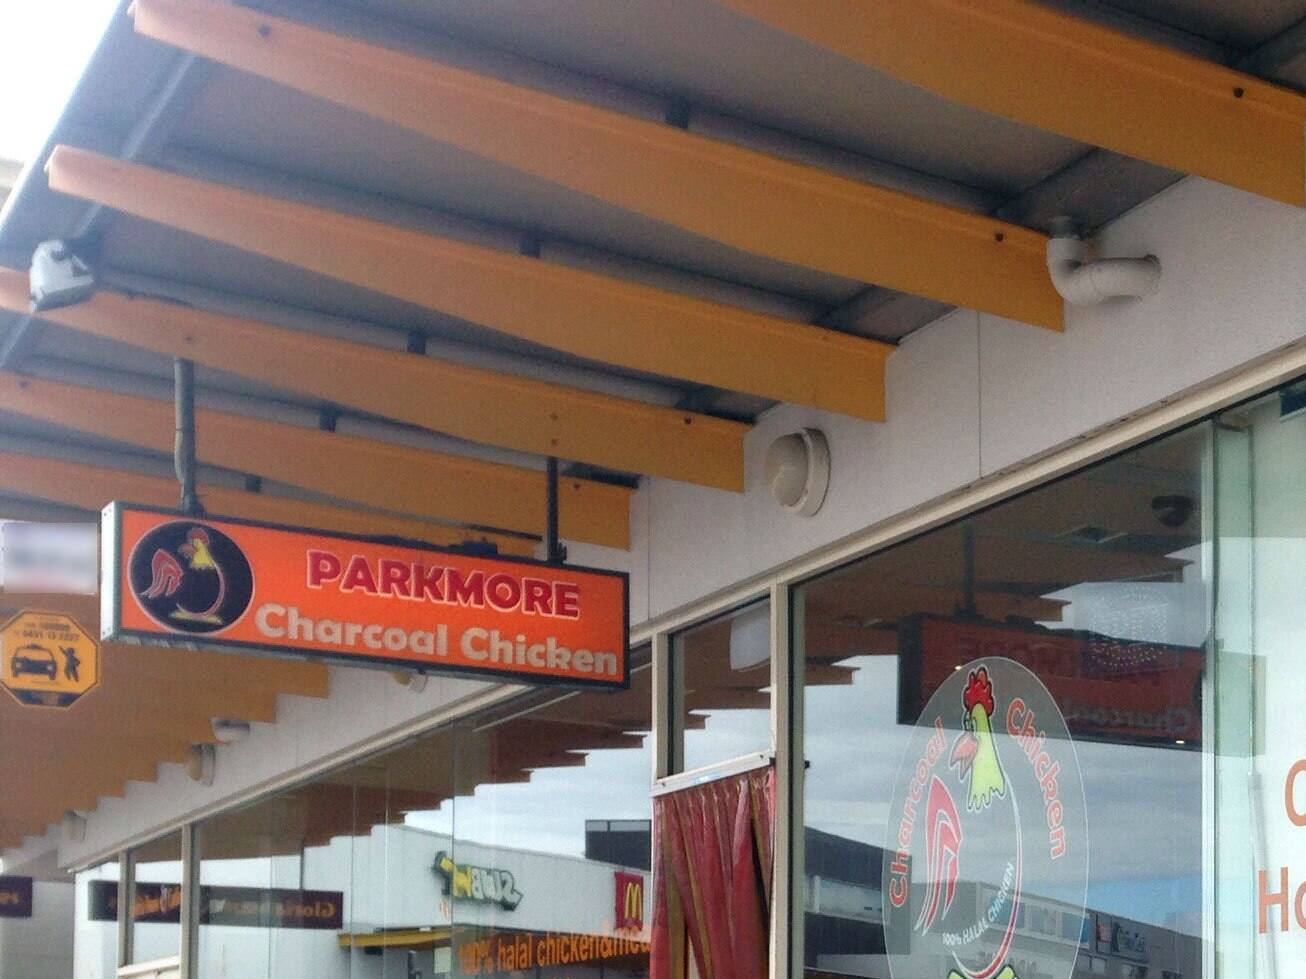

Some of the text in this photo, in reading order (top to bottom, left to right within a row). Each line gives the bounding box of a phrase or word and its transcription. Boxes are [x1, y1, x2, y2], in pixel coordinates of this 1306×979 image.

[305, 549, 581, 619] PARKMORE
[254, 602, 618, 676] Charcoal Chicken
[890, 697, 1067, 907] Charcoal Chicken
[962, 917, 989, 945] HALAL
[987, 861, 1015, 922] CHICKEN
[497, 931, 533, 972] halal
